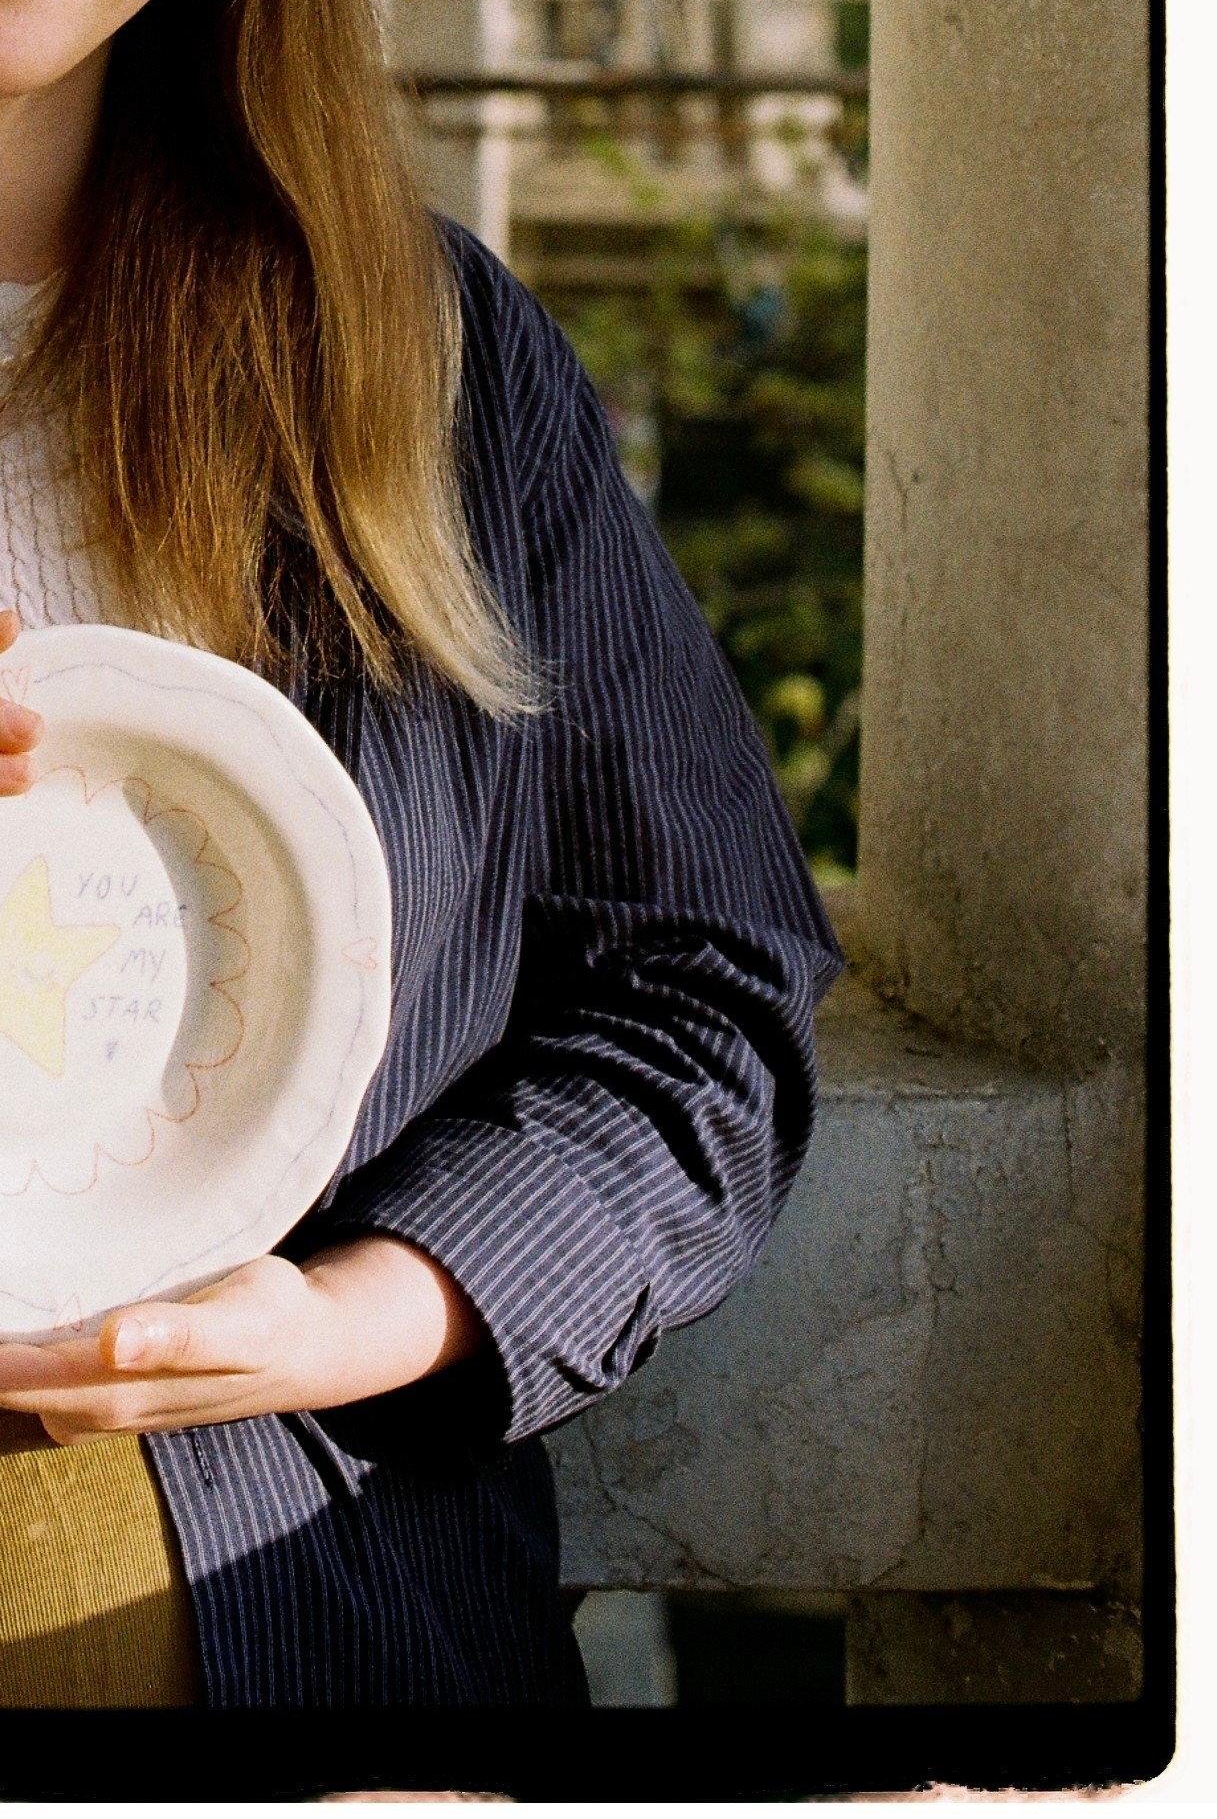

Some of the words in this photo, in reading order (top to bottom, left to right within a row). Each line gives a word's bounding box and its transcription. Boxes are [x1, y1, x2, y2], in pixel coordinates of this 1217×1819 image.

[78, 871, 138, 900] YOU
[133, 901, 187, 928] ARE
[121, 948, 166, 982] MY
[82, 995, 162, 1023] STAR
